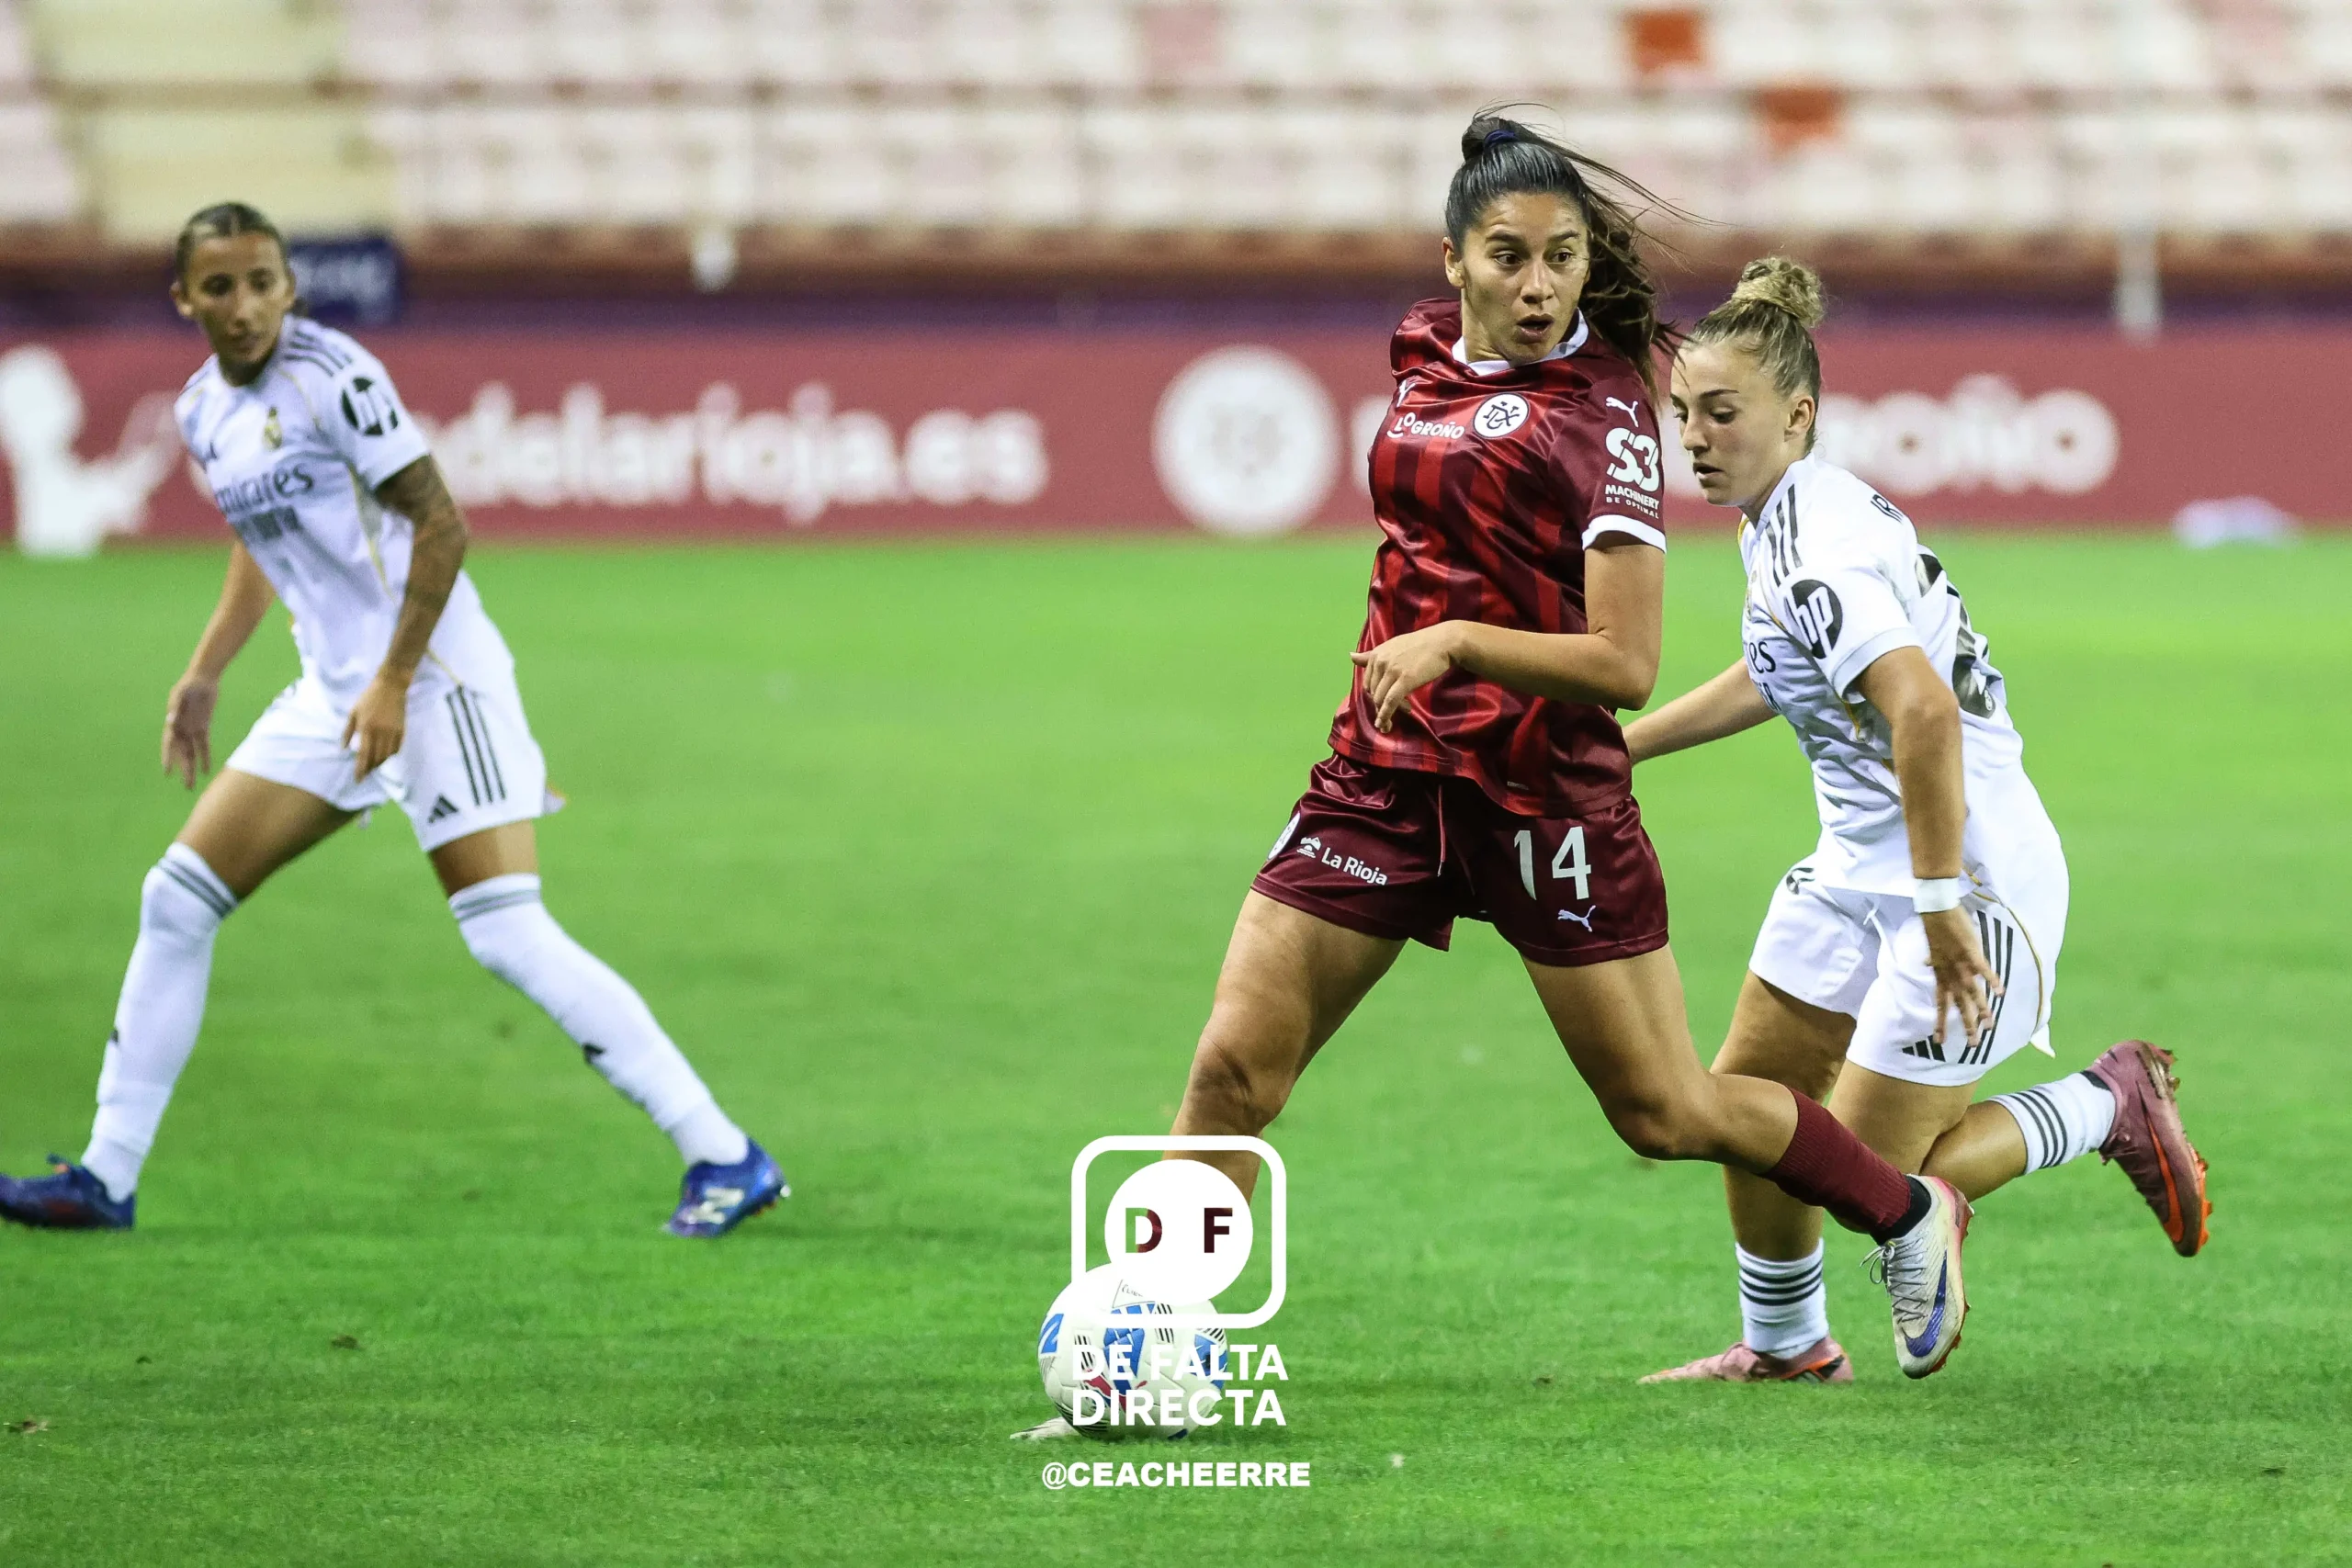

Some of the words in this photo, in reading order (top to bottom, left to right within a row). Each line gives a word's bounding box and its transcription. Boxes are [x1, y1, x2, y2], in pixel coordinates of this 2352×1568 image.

[1394, 412, 1465, 439] LOGROÑO
[1605, 427, 1660, 492] S3
[1604, 484, 1660, 511] MACHINERY
[1625, 499, 1659, 519] OPTIMAL
[1784, 579, 1843, 660] hp
[1321, 847, 1342, 869] La
[1343, 856, 1388, 886] Rioja
[1513, 826, 1592, 900] 14
